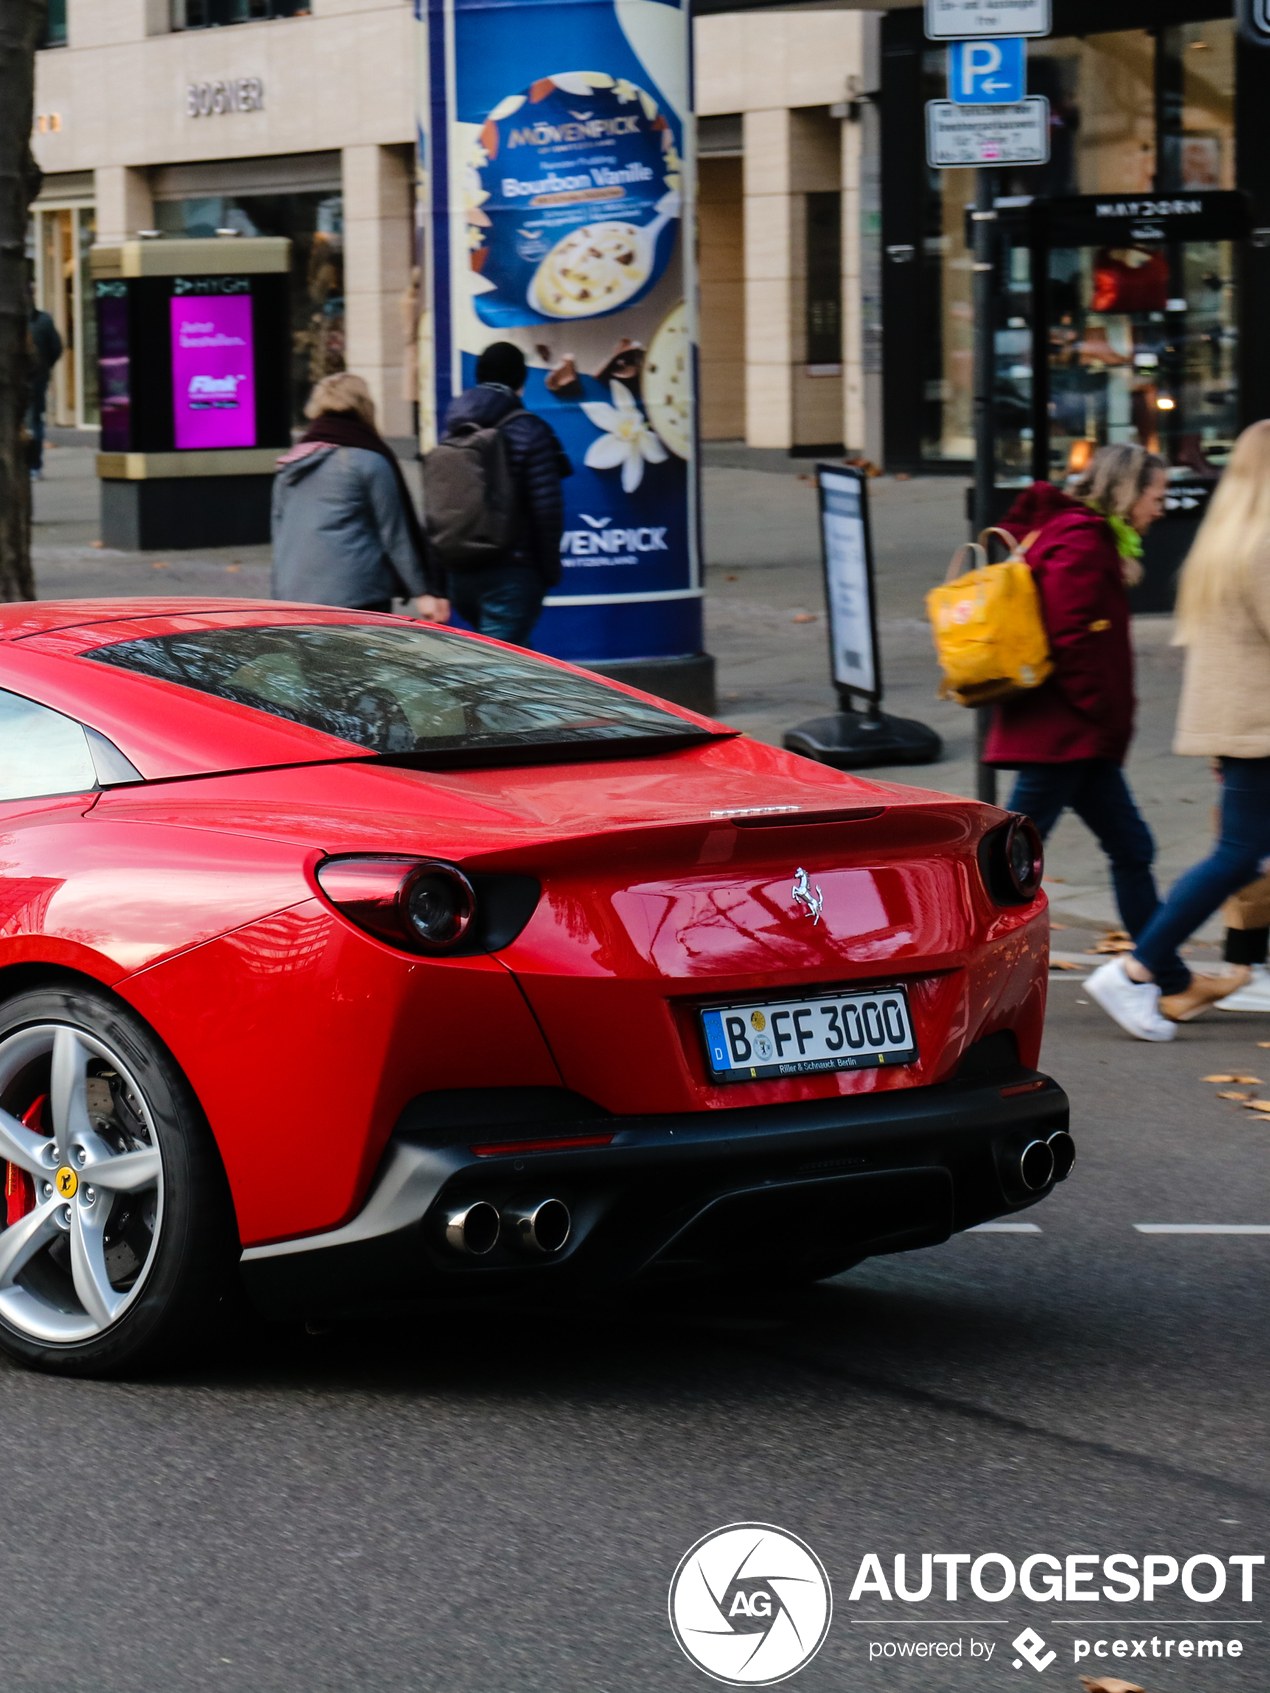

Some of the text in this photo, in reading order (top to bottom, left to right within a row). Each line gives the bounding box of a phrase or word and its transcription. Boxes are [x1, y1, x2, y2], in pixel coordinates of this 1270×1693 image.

[961, 42, 1002, 95] P
[186, 79, 263, 117] BOGNER
[507, 115, 641, 149] MÖVENPICK
[501, 172, 592, 198] Bourbon
[589, 162, 653, 186] Vanille
[189, 375, 237, 393] Flink
[559, 527, 668, 555] VENPICK
[560, 555, 639, 567] WITZERLAND
[715, 999, 906, 1062] D B FF 3000
[837, 1057, 857, 1067] Berlin
